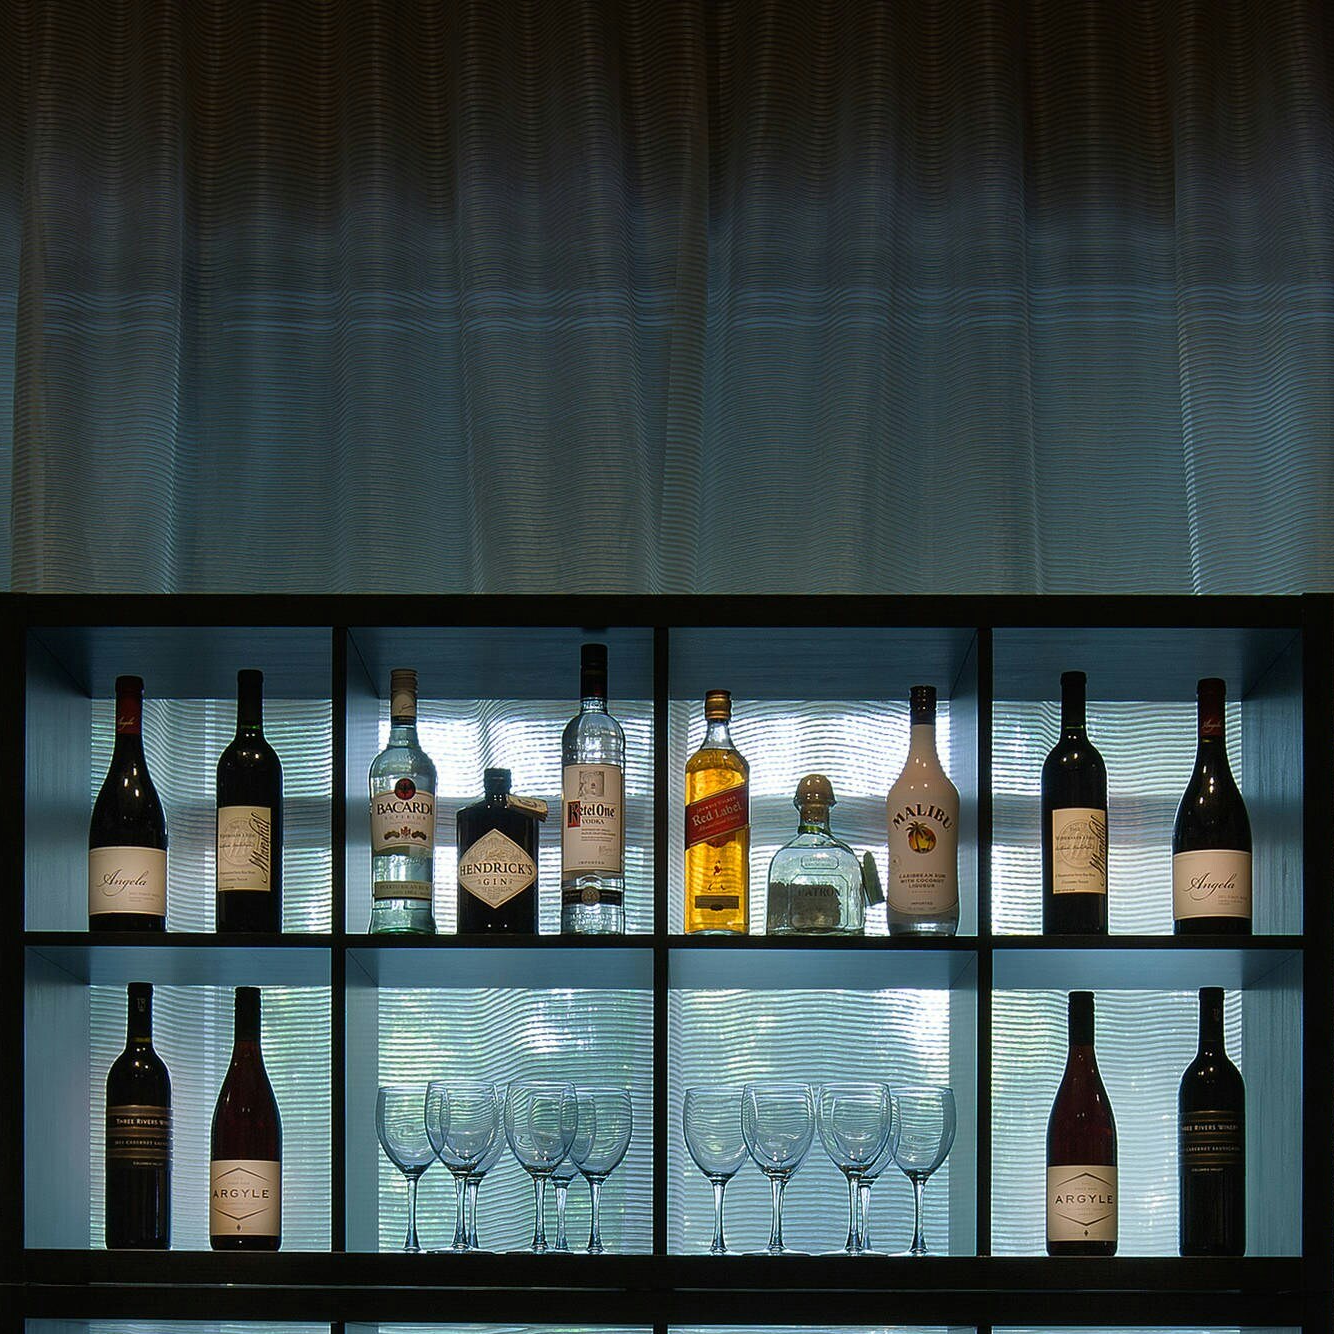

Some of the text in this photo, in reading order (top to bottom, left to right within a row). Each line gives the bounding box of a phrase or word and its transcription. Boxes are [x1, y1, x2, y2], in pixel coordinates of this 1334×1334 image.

[377, 801, 433, 815] BACARDI
[568, 802, 615, 824] Ketel One
[692, 810, 713, 826] Red
[714, 801, 742, 818] Label
[892, 803, 953, 831] MALIBU
[460, 862, 533, 876] HENDRICK'S
[97, 869, 149, 896] Angela
[1184, 872, 1237, 900] Angela
[213, 1189, 269, 1199] ARGYLE
[1055, 1194, 1113, 1204] ARGYLE
